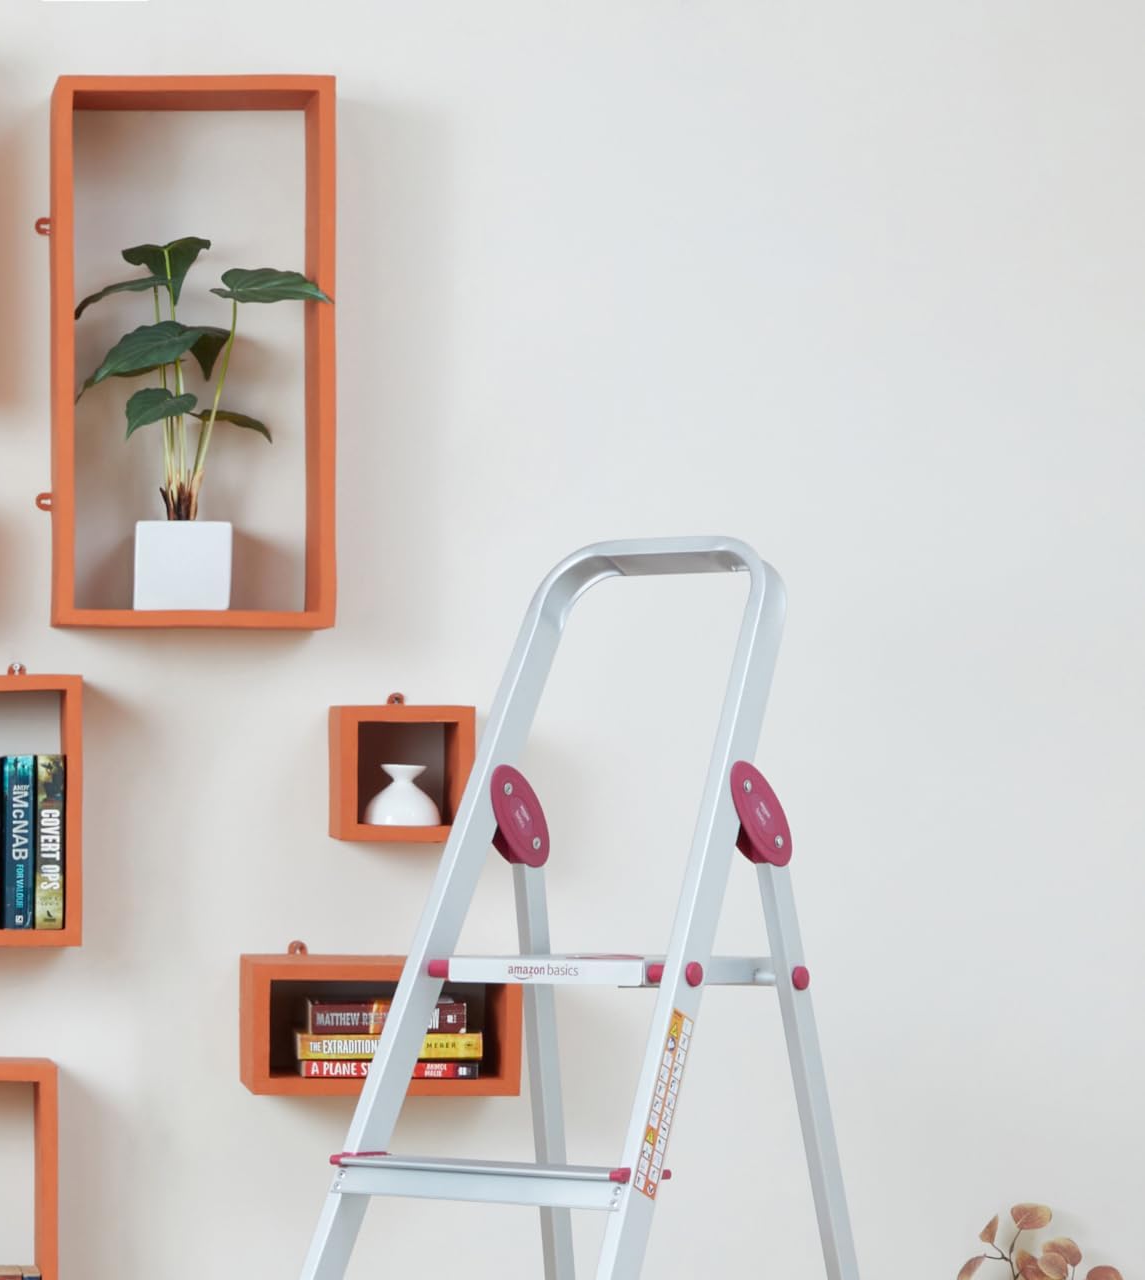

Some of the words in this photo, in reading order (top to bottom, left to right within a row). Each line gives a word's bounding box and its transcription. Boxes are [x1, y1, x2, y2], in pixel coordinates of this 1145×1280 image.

[11, 791, 29, 861] McNAB
[40, 809, 61, 860] COVERT
[16, 863, 24, 877] FOR
[40, 864, 61, 890] OPS
[16, 877, 24, 908] VALOUR
[508, 964, 545, 981] amazon
[547, 964, 579, 977] basics
[316, 1012, 360, 1026] MATTHEW
[310, 1042, 321, 1052] THE
[311, 1062, 319, 1076] A
[323, 1062, 357, 1076] PLANE
